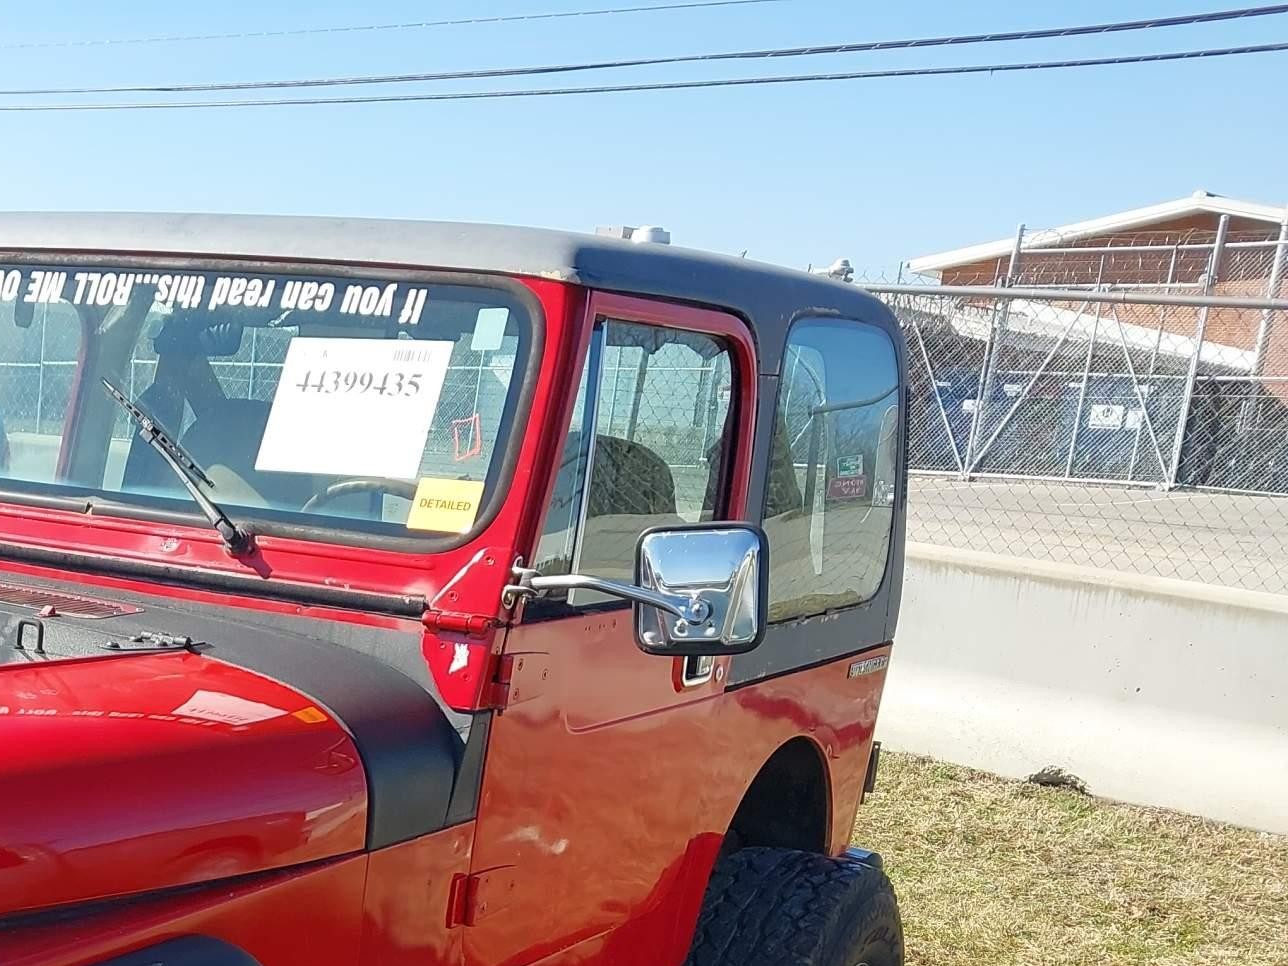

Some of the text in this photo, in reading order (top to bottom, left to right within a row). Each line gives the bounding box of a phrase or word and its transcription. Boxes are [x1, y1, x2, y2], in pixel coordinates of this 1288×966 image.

[23, 270, 67, 304] ME
[208, 276, 275, 311] read
[280, 280, 335, 312] can
[339, 283, 398, 317] you
[398, 288, 428, 324] If
[295, 370, 424, 398] 44399435
[418, 497, 472, 512] DETAILED
